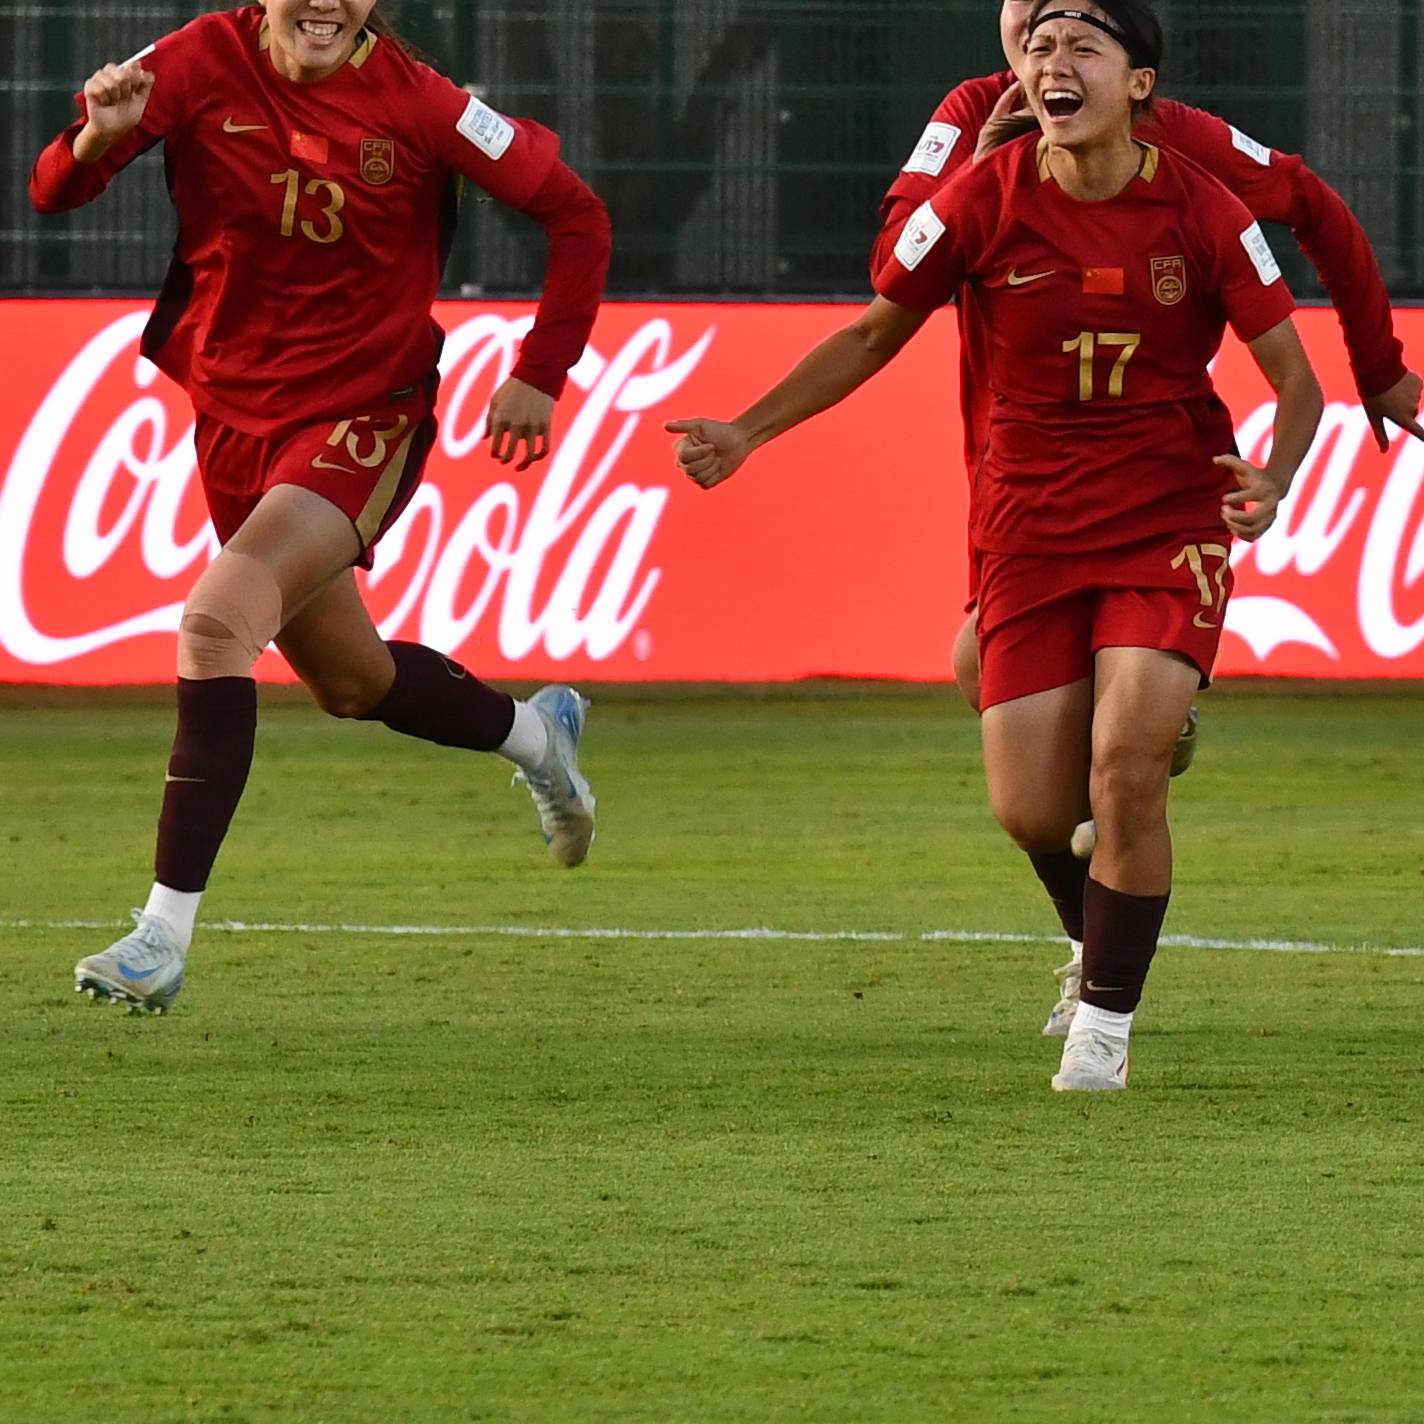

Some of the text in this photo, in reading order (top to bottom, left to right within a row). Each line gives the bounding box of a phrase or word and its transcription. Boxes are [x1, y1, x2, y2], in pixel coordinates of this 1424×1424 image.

[270, 168, 345, 244] 13
[1062, 331, 1141, 401] 17
[1170, 543, 1228, 614] 17
